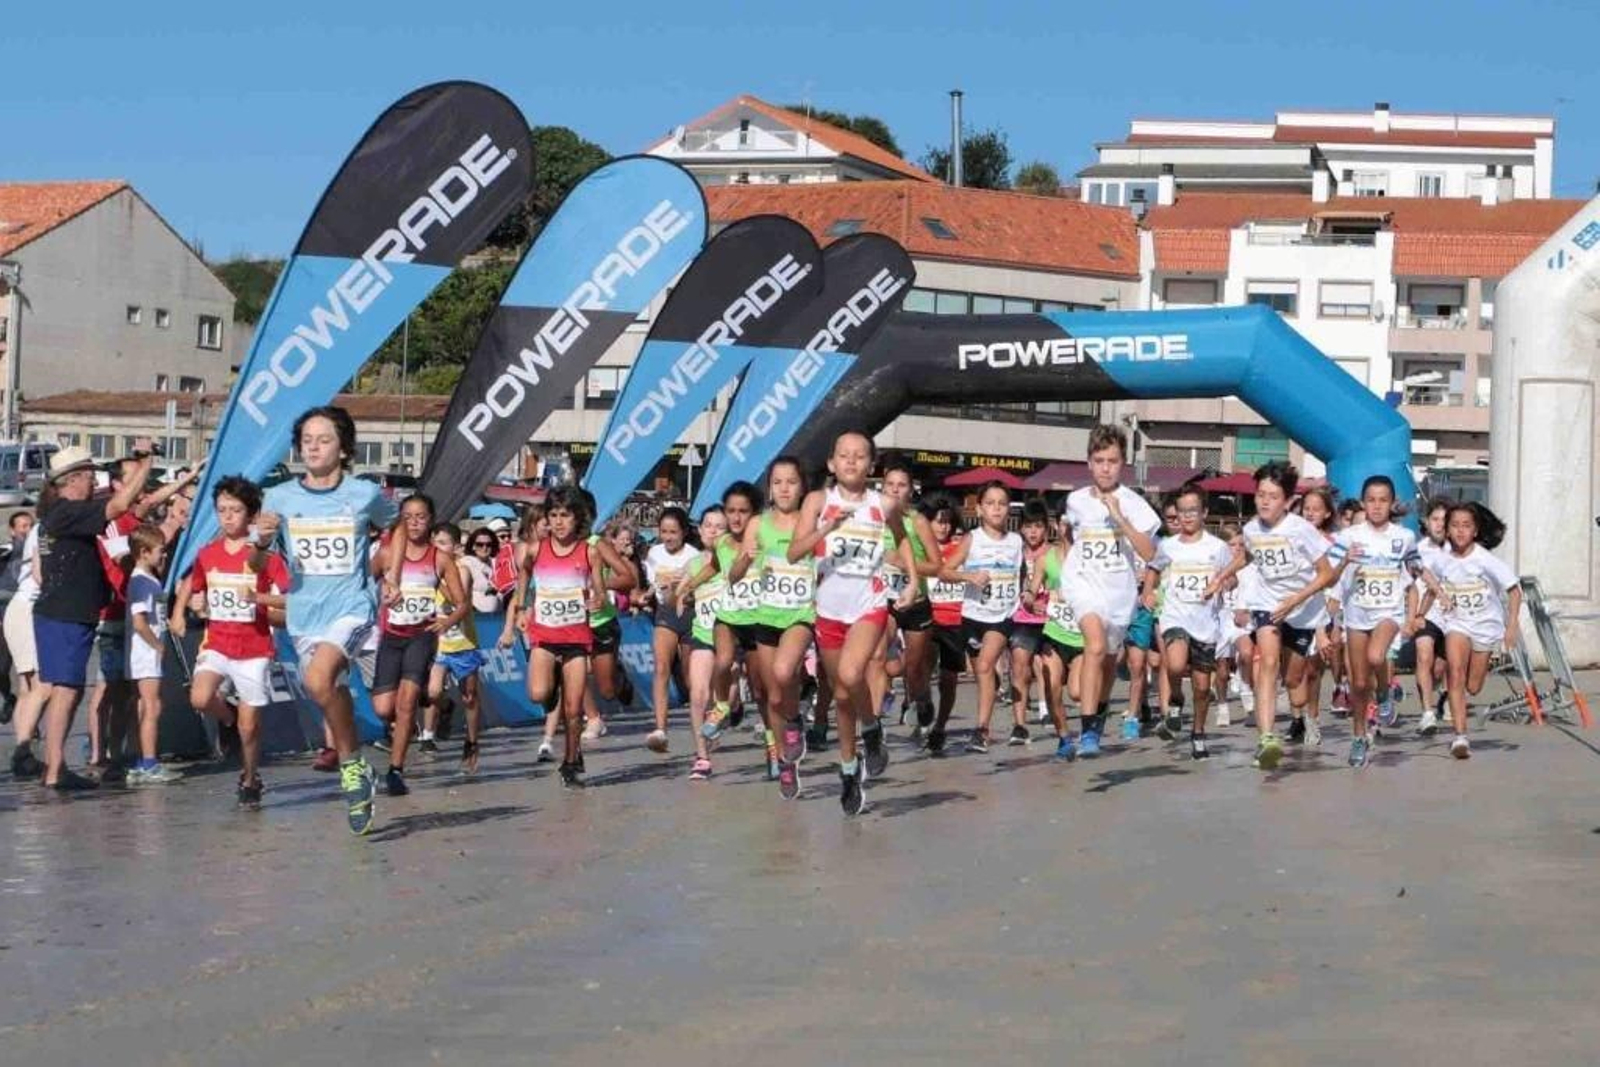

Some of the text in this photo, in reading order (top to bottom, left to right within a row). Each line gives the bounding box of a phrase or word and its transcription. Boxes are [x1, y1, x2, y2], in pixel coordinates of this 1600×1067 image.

[237, 133, 507, 427] POWERADE
[457, 198, 690, 452] POWERADE
[605, 253, 808, 465] POWERADE
[958, 334, 1190, 370] POWERADE
[726, 267, 901, 462] POWERADE
[971, 456, 1031, 470] BEIRAMAR
[296, 537, 348, 560] 359
[832, 536, 878, 560] 377
[1082, 541, 1121, 560] 524
[982, 583, 1016, 600] 415
[1175, 575, 1209, 591] 421
[1356, 579, 1393, 597] 363
[540, 599, 581, 616] 395
[1052, 605, 1074, 622] 38
